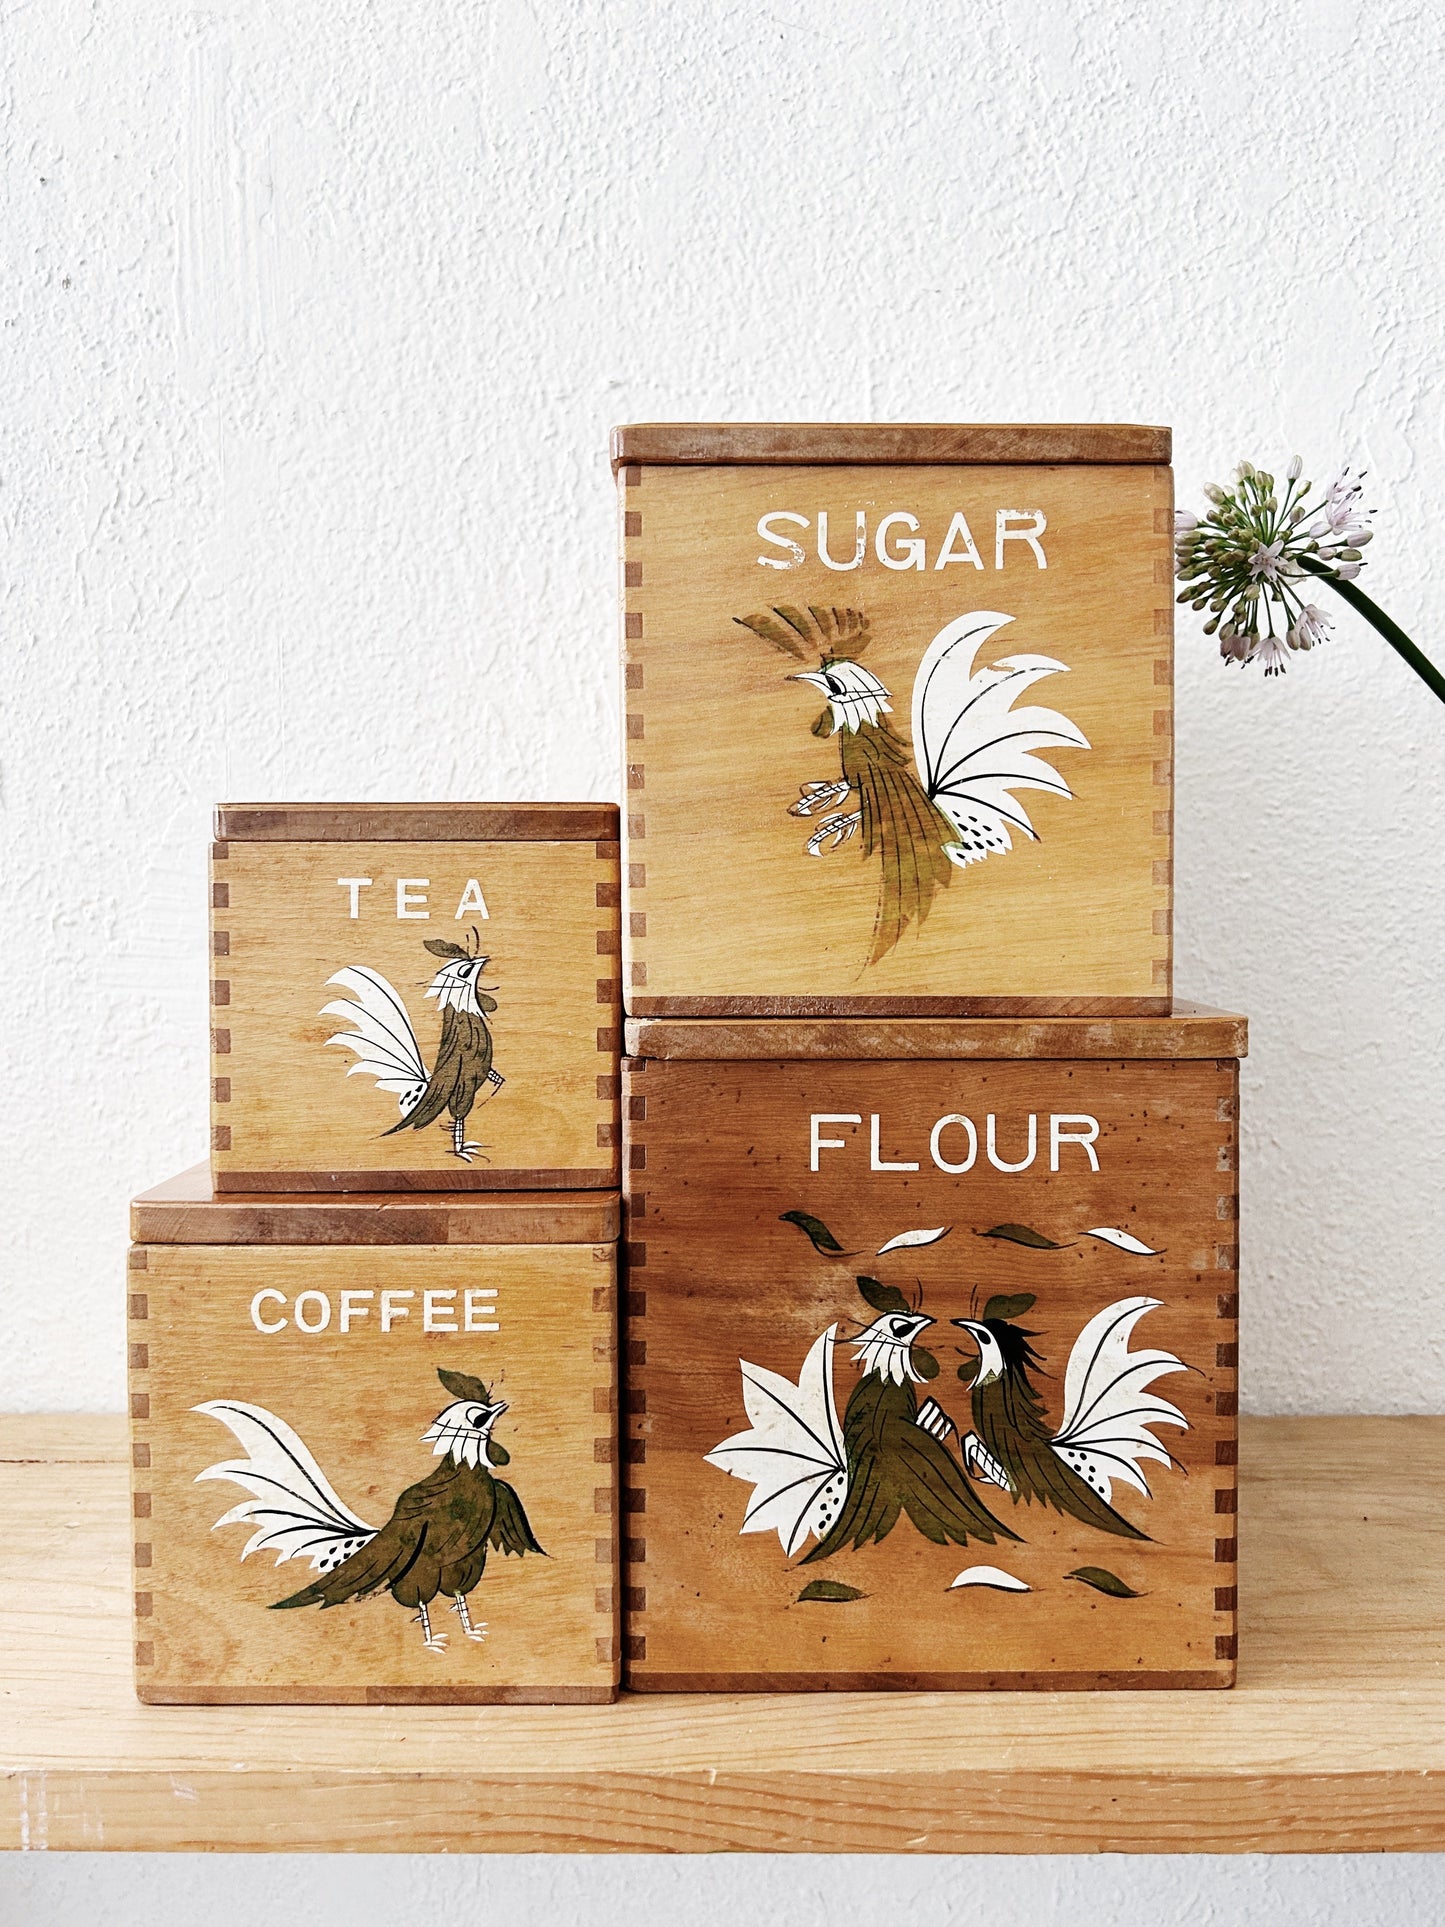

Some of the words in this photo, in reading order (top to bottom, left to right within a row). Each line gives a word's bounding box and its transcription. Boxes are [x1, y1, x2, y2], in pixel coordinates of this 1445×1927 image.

[756, 508, 1048, 572] SUGAR
[336, 877, 490, 920] TEA
[809, 1113, 1100, 1173] FLOUR
[249, 1287, 500, 1334] COFFEE
